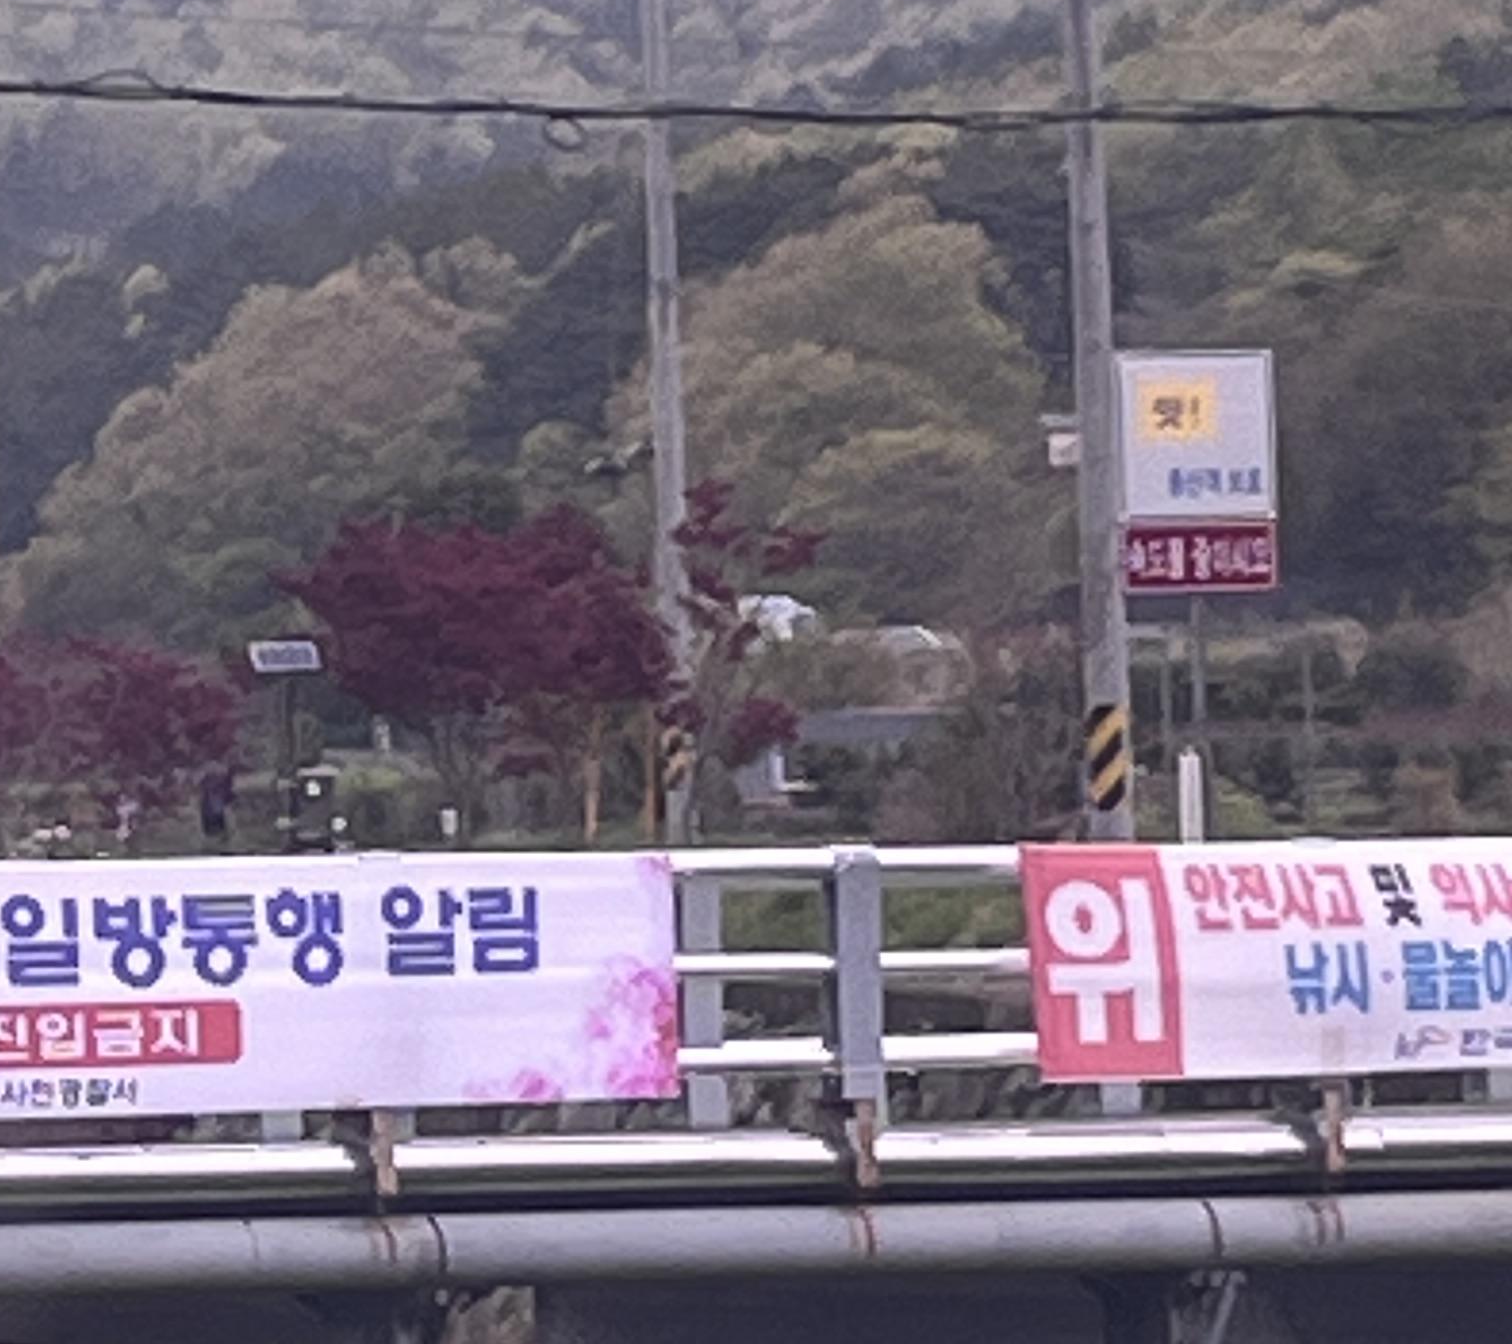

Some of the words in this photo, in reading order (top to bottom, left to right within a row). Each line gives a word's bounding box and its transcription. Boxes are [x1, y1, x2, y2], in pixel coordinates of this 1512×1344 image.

[0, 889, 344, 989] 일방통행
[381, 886, 540, 977] 알림
[1183, 864, 1364, 931] 안전사고
[1369, 864, 1423, 927] 및
[1044, 878, 1166, 1044] 위
[0, 1078, 139, 1110] 사천경찰서
